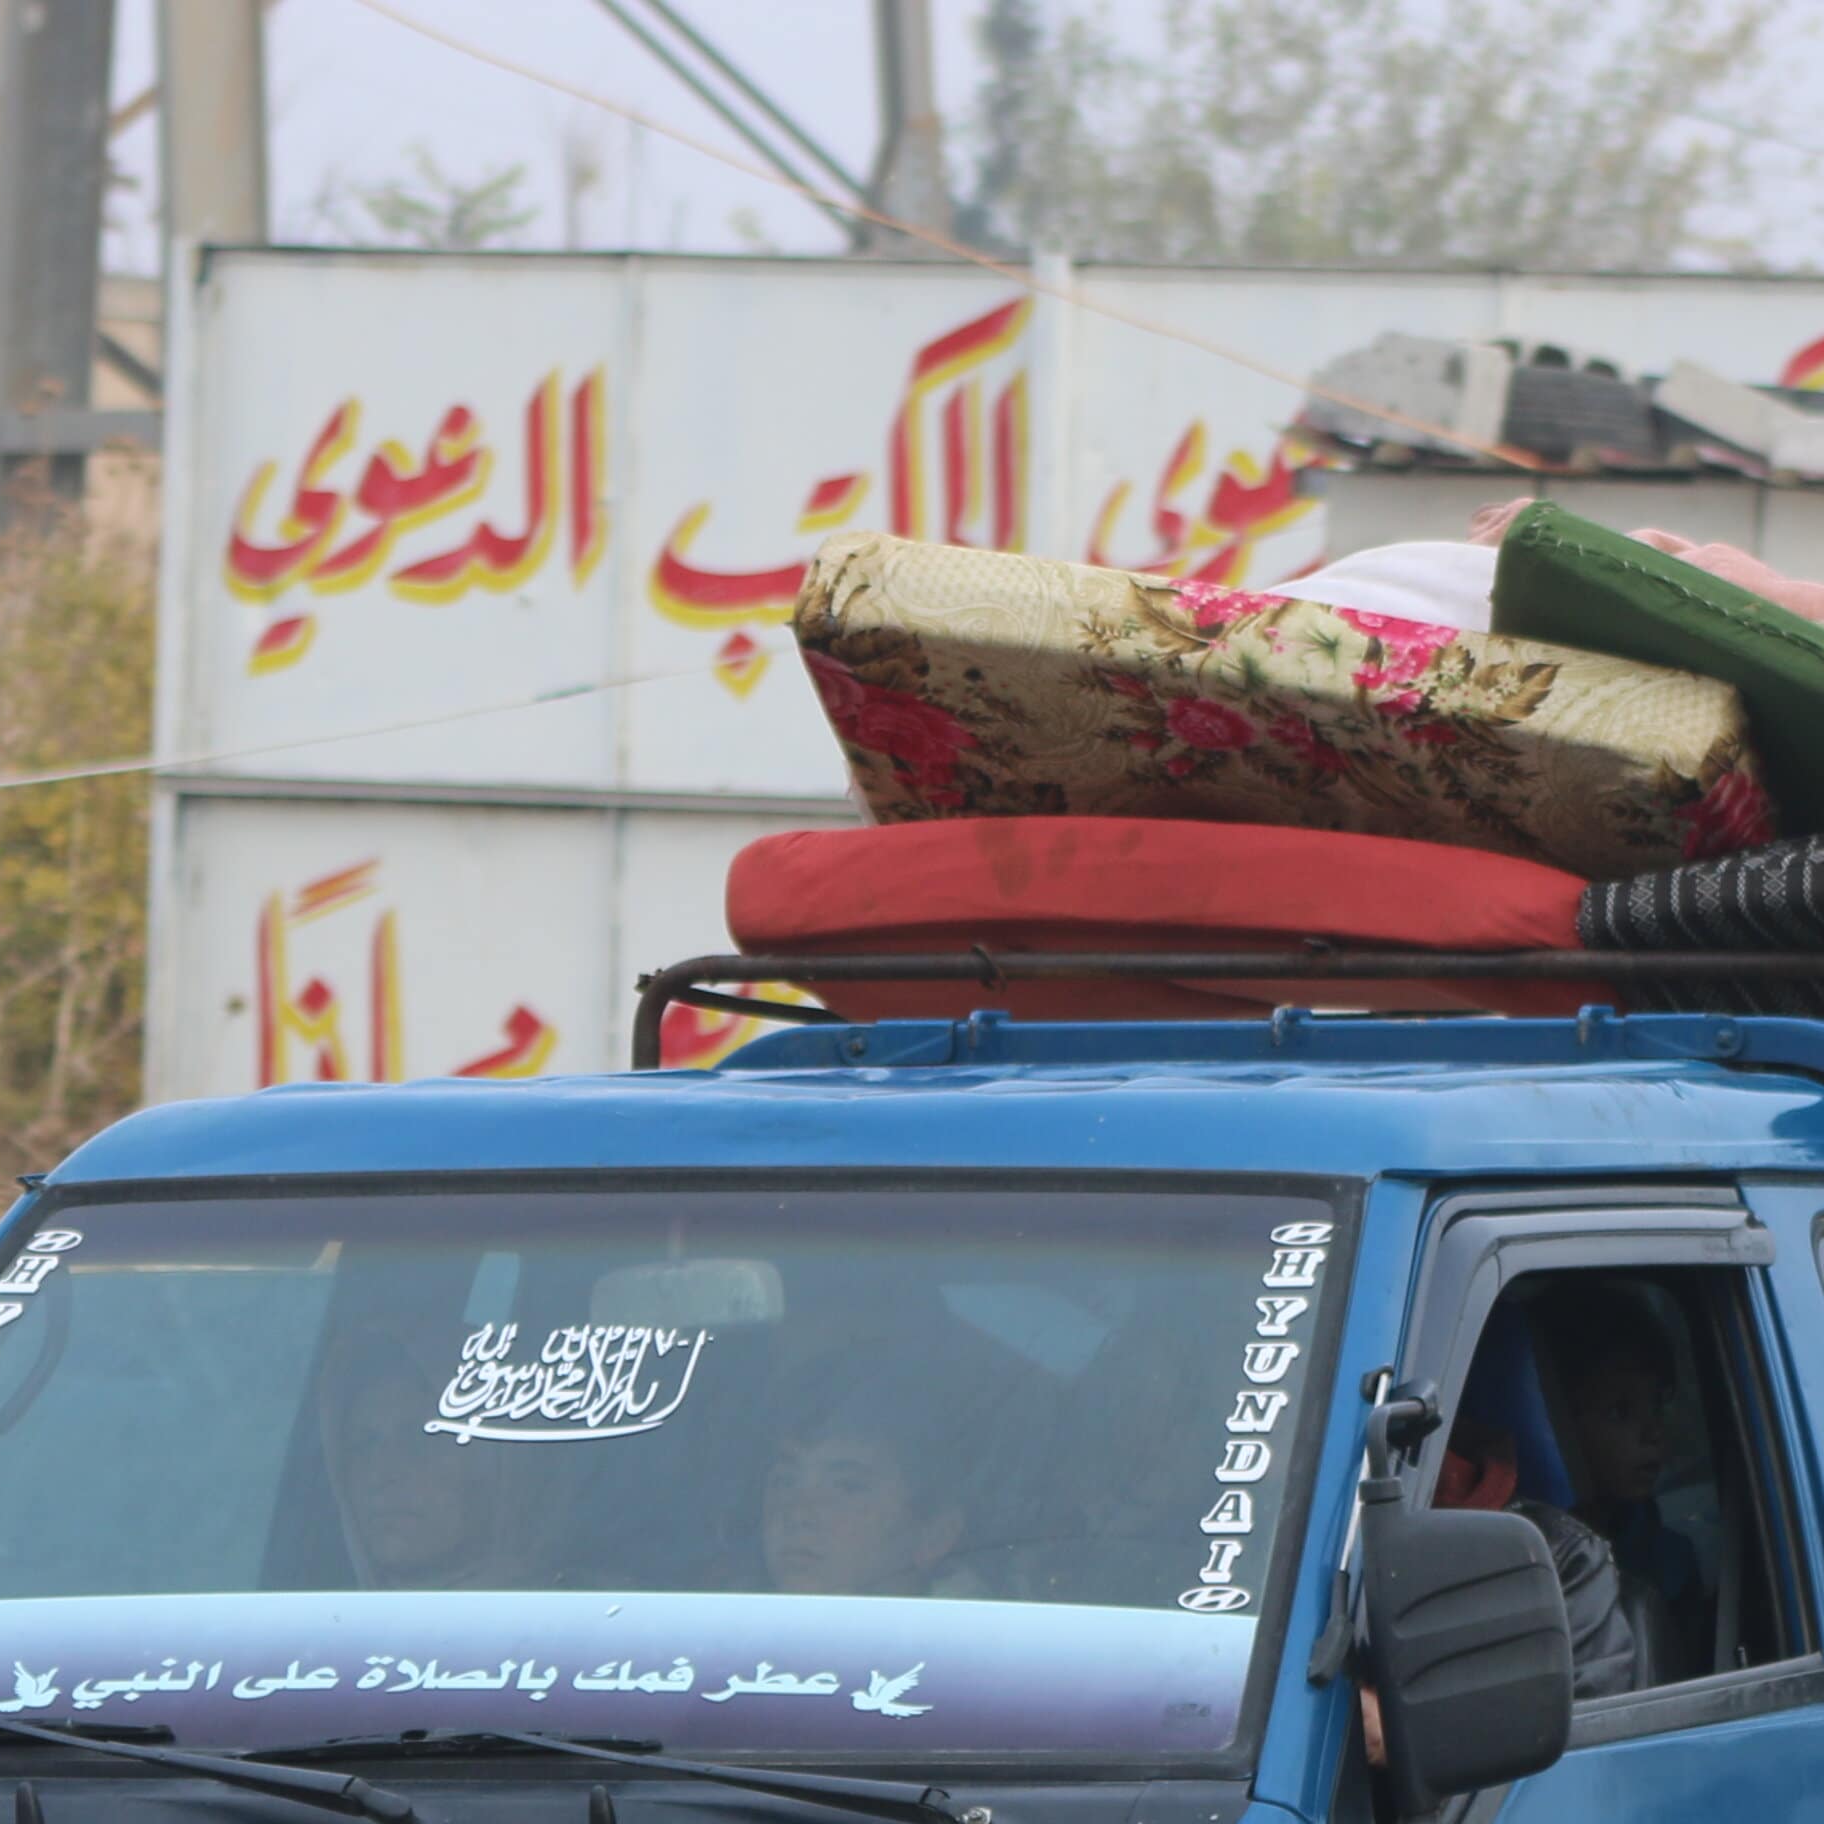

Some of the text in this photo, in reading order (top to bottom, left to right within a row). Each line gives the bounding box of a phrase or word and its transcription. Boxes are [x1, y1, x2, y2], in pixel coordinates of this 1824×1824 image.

[1197, 1248, 1326, 1585] HYUNDAI
[71, 1655, 842, 1711] عطر فمك بالصلاة على النبي
